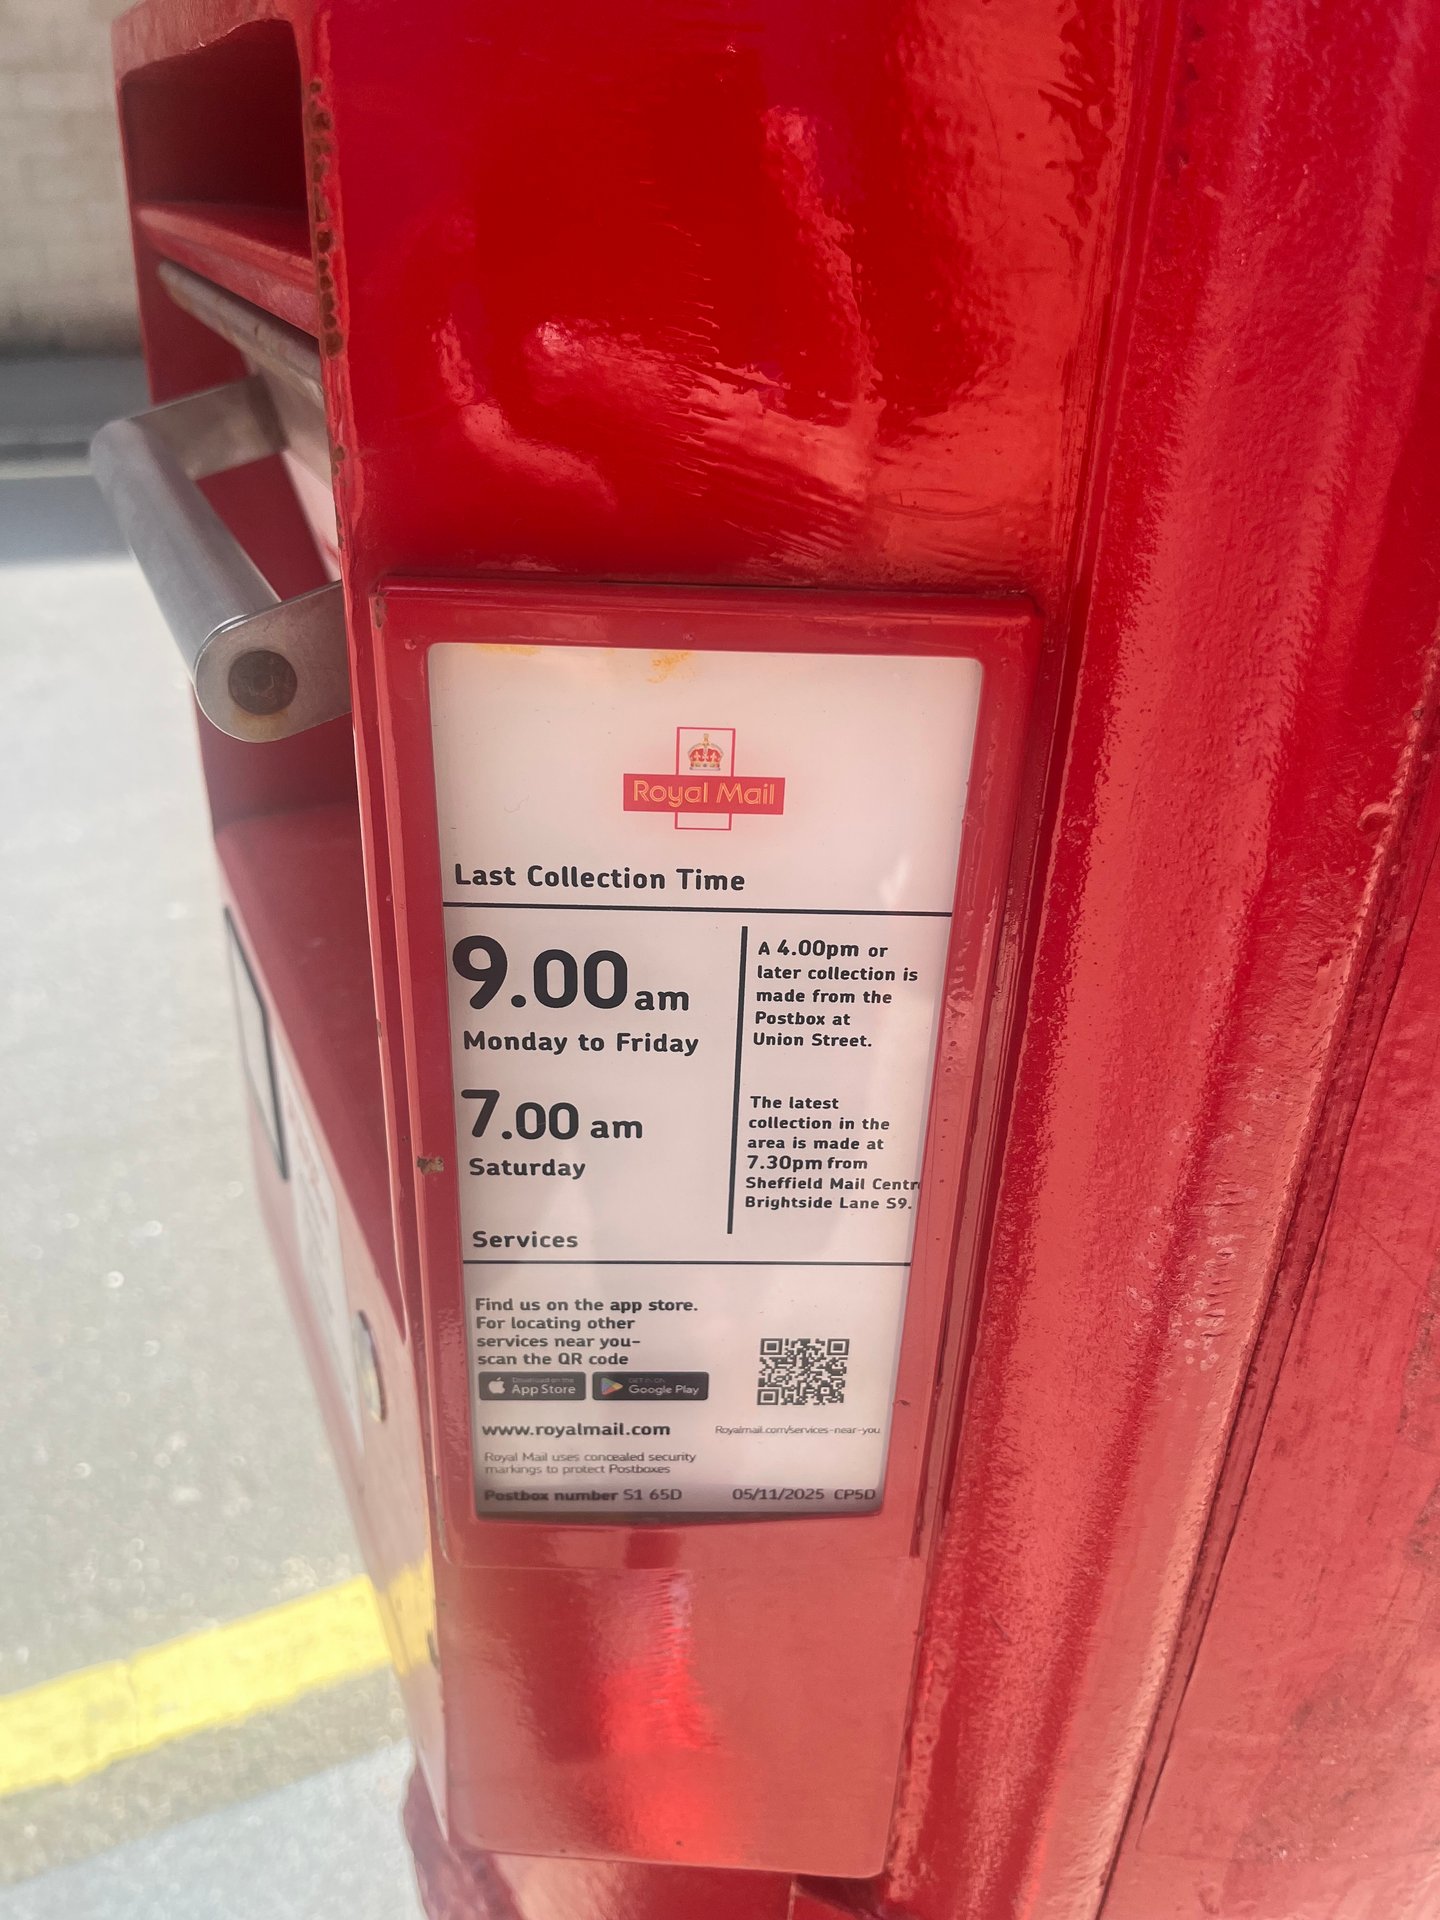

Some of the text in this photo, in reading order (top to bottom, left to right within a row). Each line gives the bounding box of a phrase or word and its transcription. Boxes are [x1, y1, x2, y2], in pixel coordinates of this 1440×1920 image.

[633, 780, 775, 808] Royal Mail
[455, 864, 745, 891] Last Collection Time
[758, 939, 888, 959] A 4.00pm or
[453, 936, 690, 1011] 9.00 am
[757, 965, 918, 981] later collection is
[756, 989, 893, 1003] made from the
[755, 1011, 851, 1025] Postbox at
[463, 1031, 699, 1056] Monday to Friday
[753, 1032, 872, 1047] Union Street.
[750, 1096, 839, 1109] The latest
[461, 1089, 643, 1140] 7.00 am
[749, 1117, 890, 1130] collection in the
[747, 1137, 884, 1150] area is made at
[469, 1158, 586, 1180] Saturday
[747, 1155, 868, 1173] 7.30pm from
[745, 1176, 823, 1190] Sheffield
[830, 1178, 865, 1190] Mail
[745, 1196, 912, 1211] Brightside Lane S9.
[472, 1231, 578, 1249] Services
[475, 1298, 698, 1314] Find us on the app store.
[476, 1316, 635, 1332] For locating other
[476, 1335, 549, 1347] services
[554, 1337, 595, 1347] near
[477, 1352, 629, 1366] scan the QR code
[511, 1384, 577, 1397] App Store
[628, 1384, 700, 1396] Google Play
[482, 1423, 671, 1438] www.royalmail.com
[715, 1425, 881, 1436] Royalmail.com/services-near-you
[484, 1452, 696, 1463] Royal Mail uses concealed security
[484, 1465, 671, 1476] markings to protect Postboxes
[484, 1488, 683, 1501] Postbox number S1 65D
[732, 1488, 825, 1501] 05/11/2025
